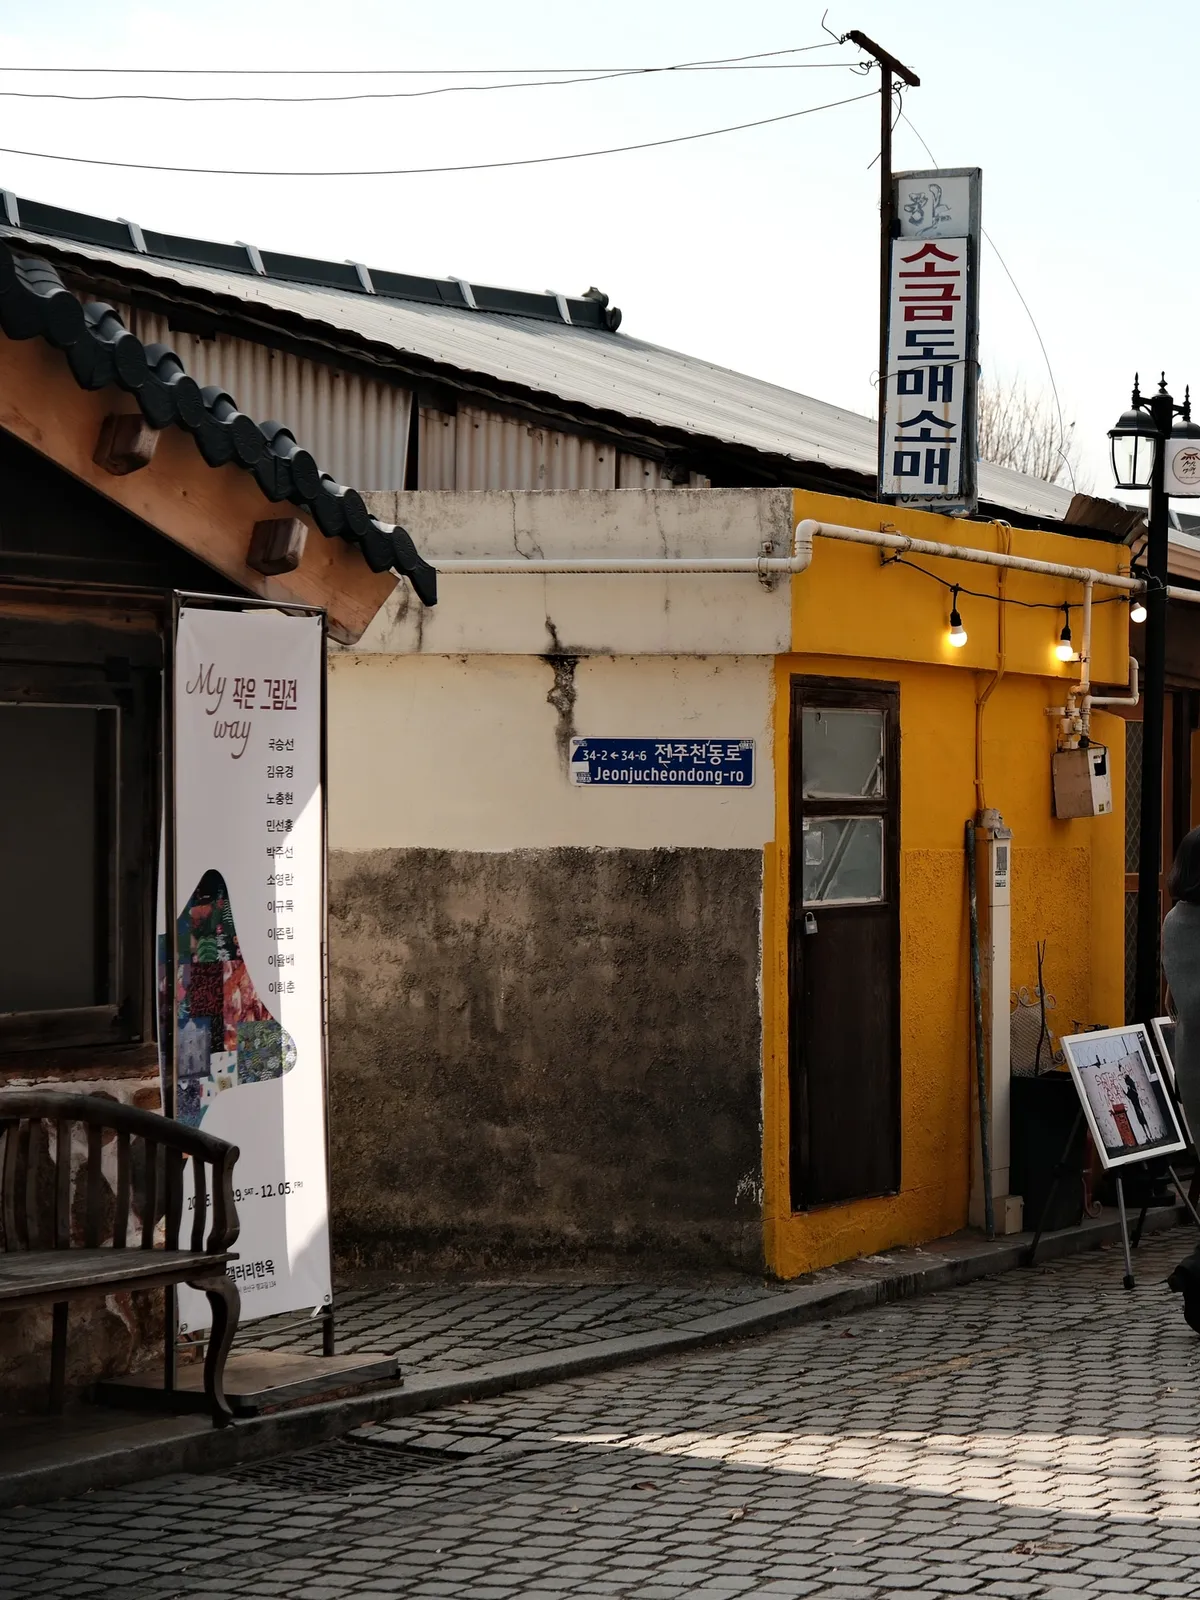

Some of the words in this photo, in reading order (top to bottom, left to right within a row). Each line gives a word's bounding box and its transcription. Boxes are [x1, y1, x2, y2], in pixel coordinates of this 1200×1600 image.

[186, 663, 227, 715] My
[233, 677, 256, 709] 작은
[260, 679, 298, 710] 그림전
[213, 720, 251, 760] way
[268, 738, 294, 751] 국승선
[582, 750, 608, 761] 34-2
[654, 743, 742, 766] 전주천동로
[267, 765, 294, 778] 김유경
[594, 766, 744, 784] Jeonjucheondong-ro
[266, 792, 293, 805] 노충현
[266, 846, 293, 859] 박주선
[266, 873, 294, 886] 소영란
